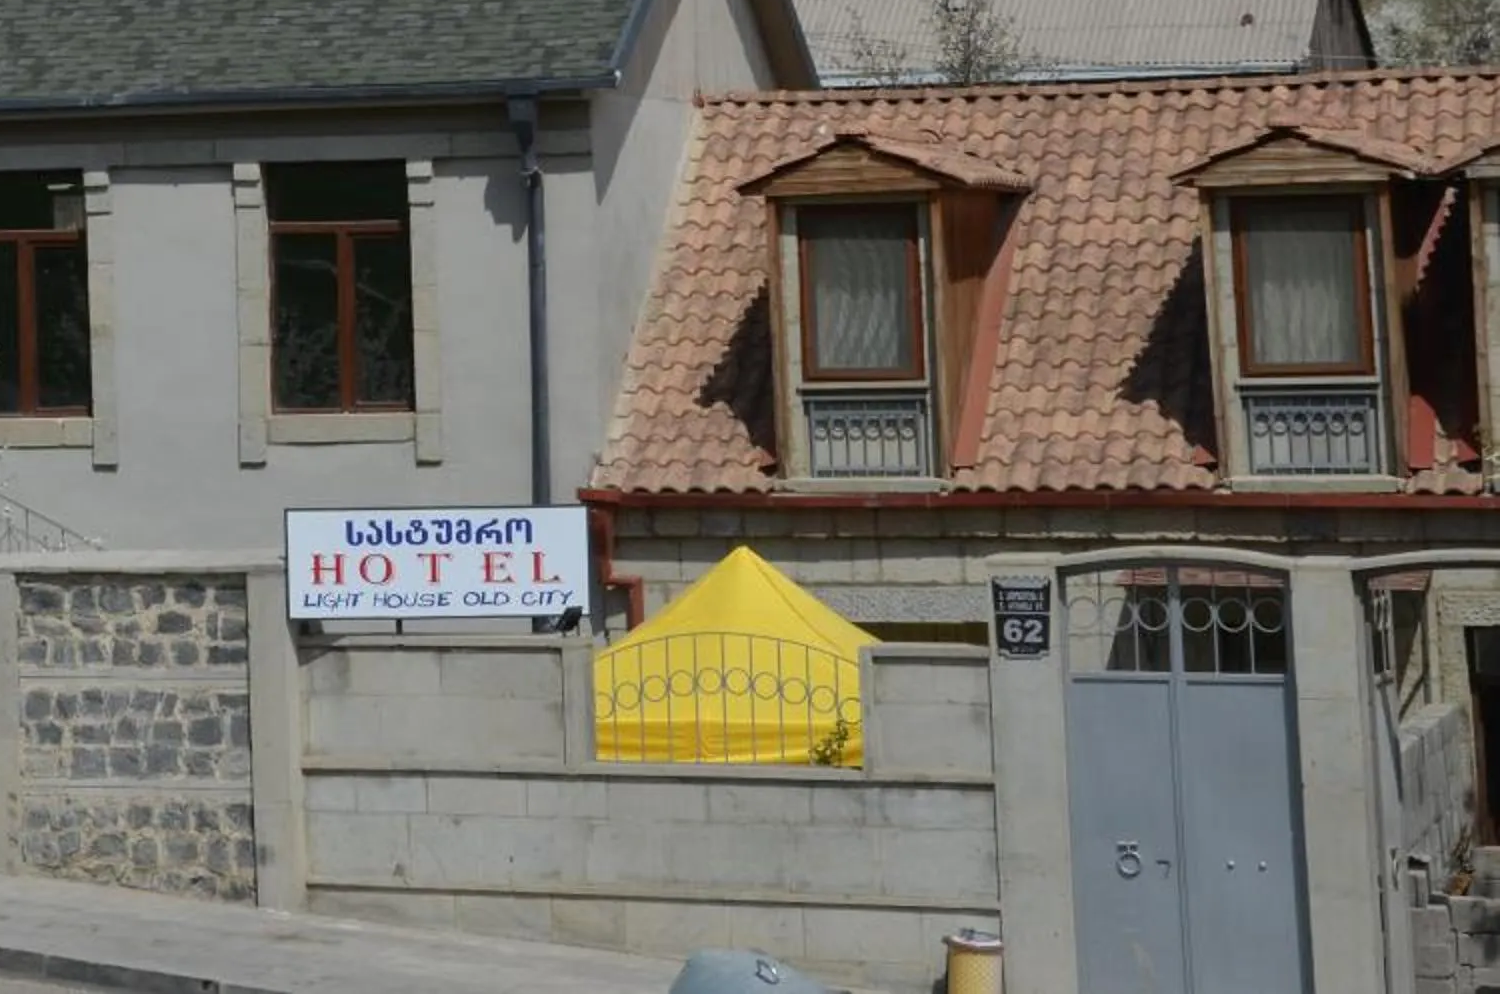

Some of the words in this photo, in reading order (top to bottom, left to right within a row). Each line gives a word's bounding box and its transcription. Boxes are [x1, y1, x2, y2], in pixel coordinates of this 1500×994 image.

[345, 517, 533, 546] სასტუმრო
[310, 550, 563, 586] HOTEL
[303, 590, 364, 610] LIGHT
[373, 590, 453, 608] HOUSE
[463, 590, 510, 606] OLD
[521, 589, 574, 607] CITY
[1003, 619, 1044, 643] 62
